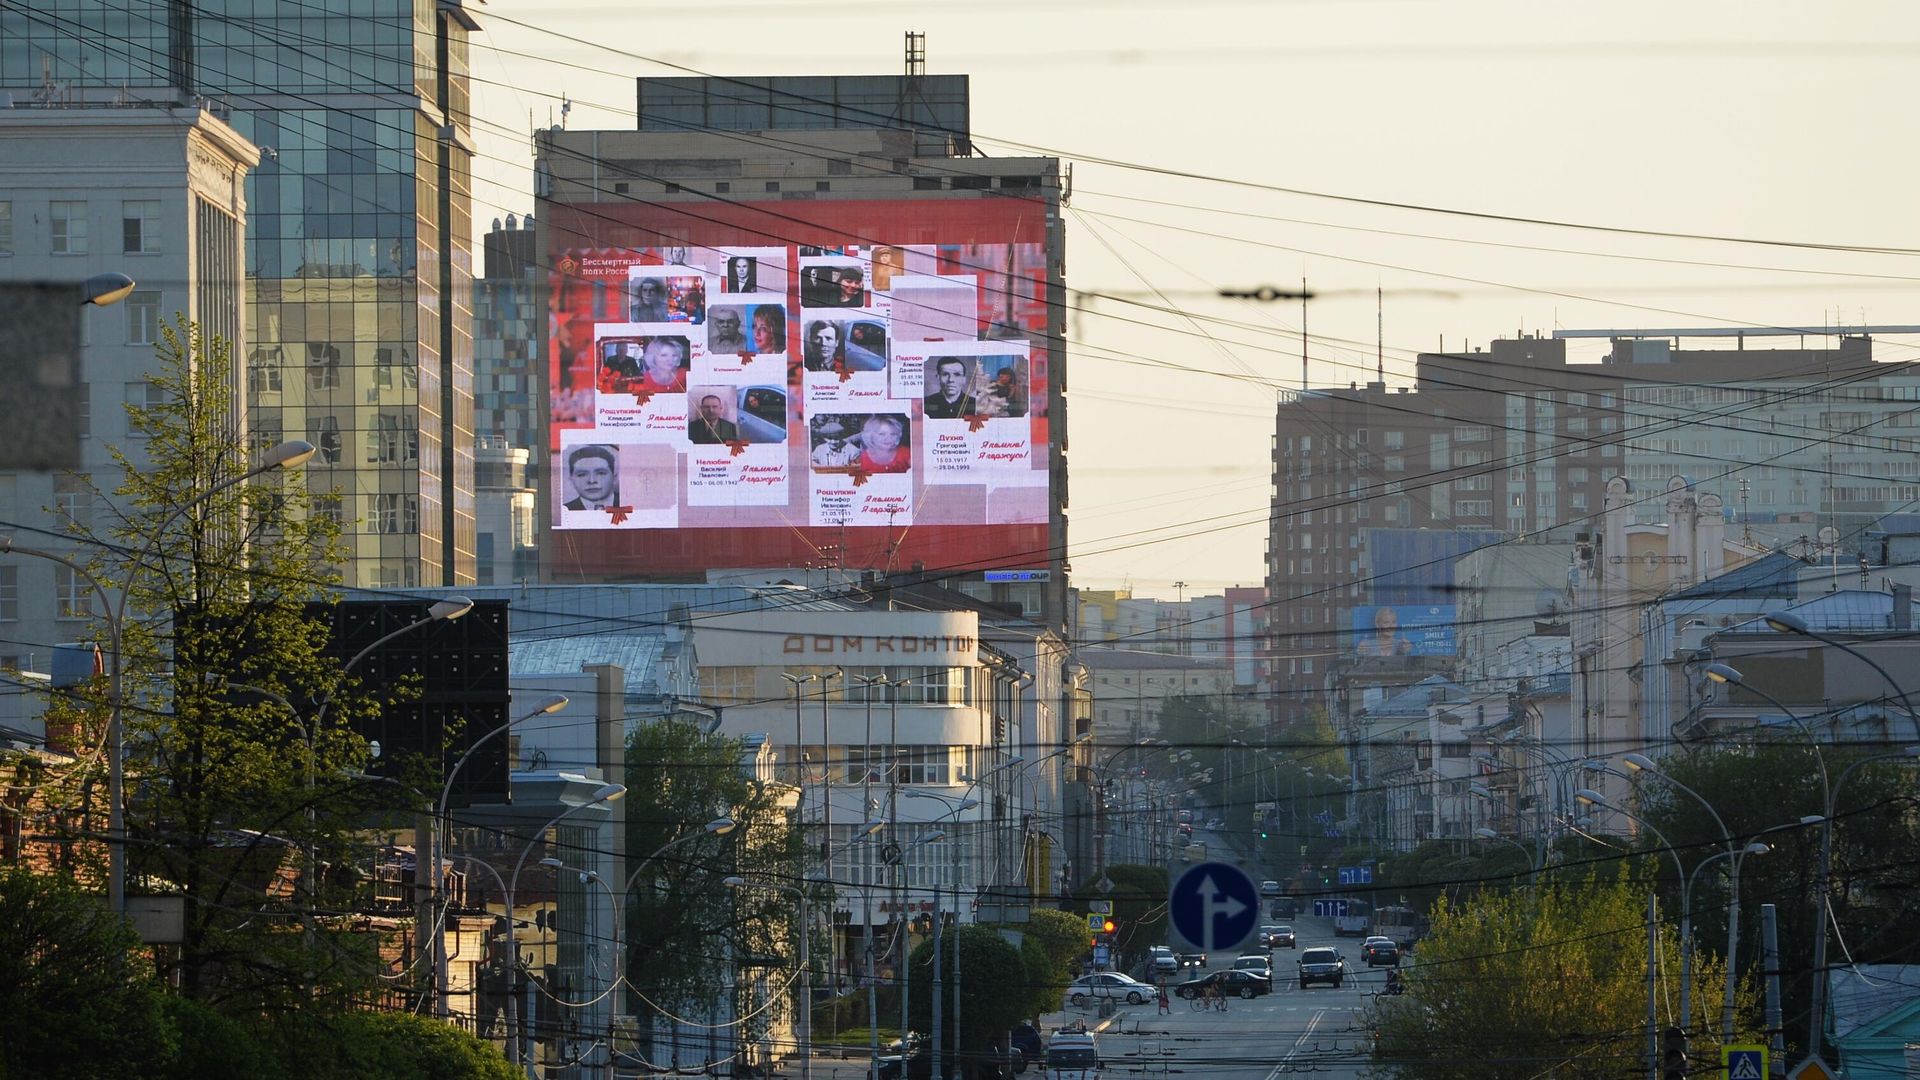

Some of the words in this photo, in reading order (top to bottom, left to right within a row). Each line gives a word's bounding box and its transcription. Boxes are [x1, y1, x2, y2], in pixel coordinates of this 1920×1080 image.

[582, 258, 641, 267] Бессмертный
[980, 441, 989, 449] Я
[989, 440, 1025, 448] помню!
[978, 452, 986, 460] Я
[986, 450, 1029, 462] горжусь!
[1425, 631, 1446, 639] SMILE
[783, 635, 863, 653] ДОМ
